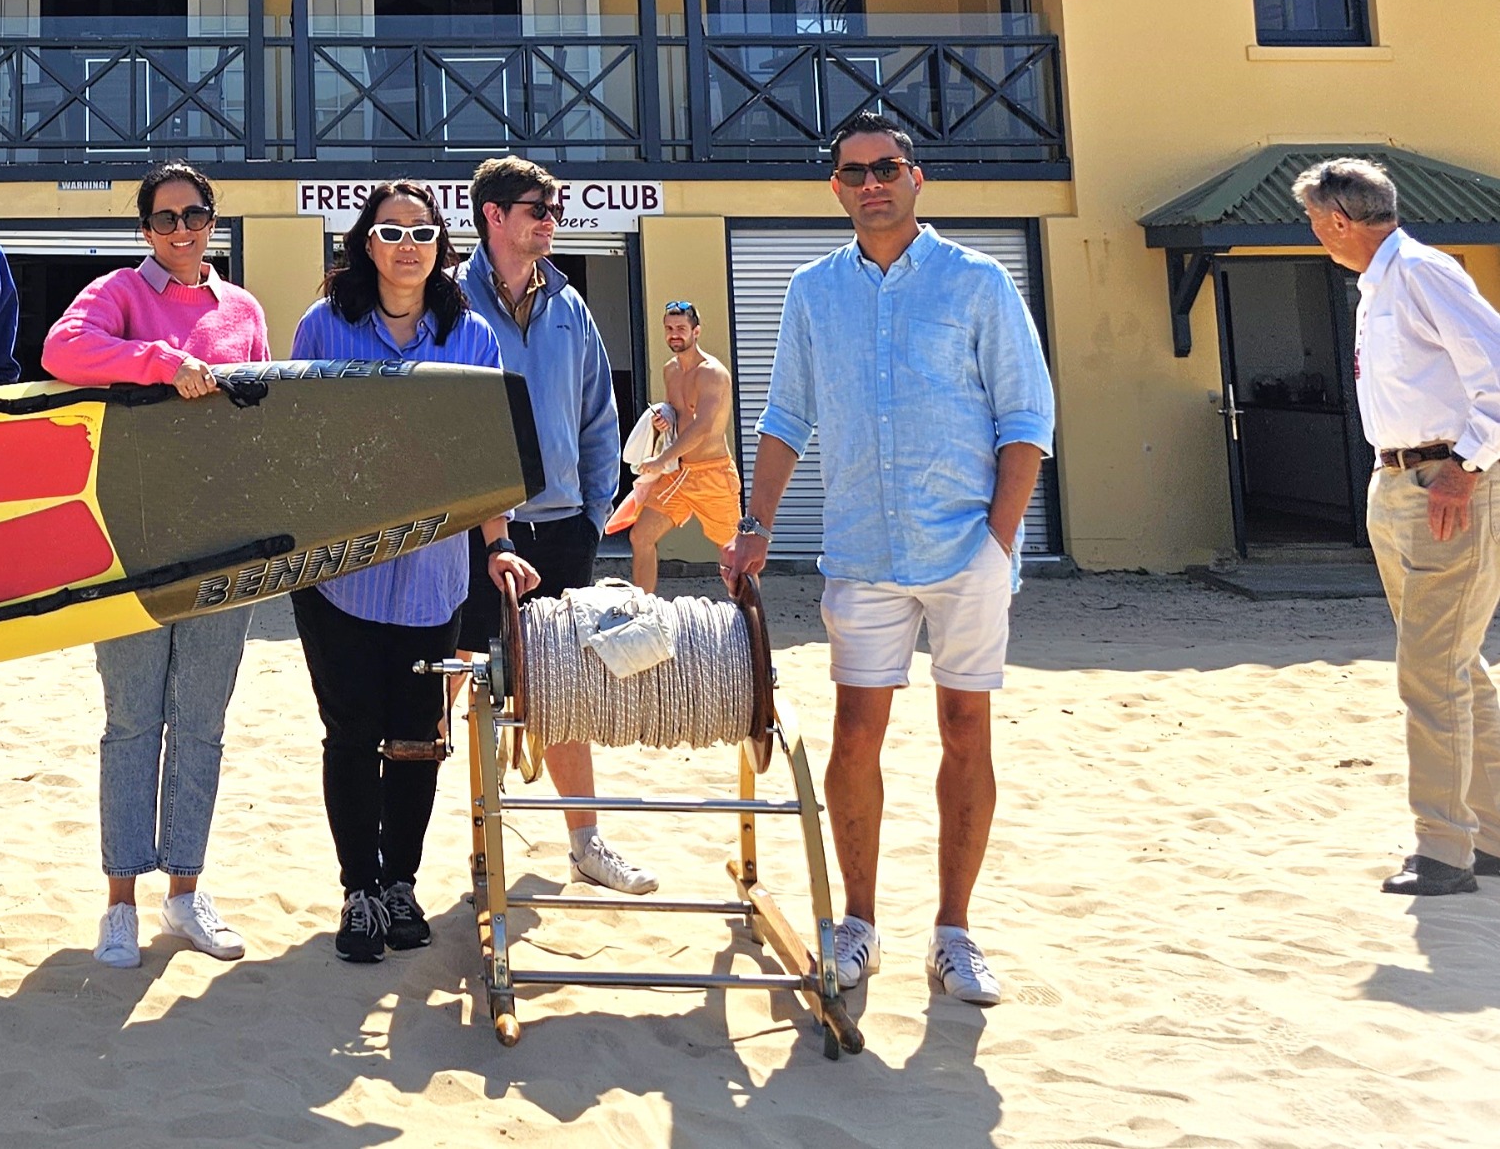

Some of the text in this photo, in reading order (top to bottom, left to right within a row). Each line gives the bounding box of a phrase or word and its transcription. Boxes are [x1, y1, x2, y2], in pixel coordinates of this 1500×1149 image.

[61, 181, 108, 189] WARNING!
[582, 184, 658, 210] CLUB
[193, 513, 449, 612] BENNETT
